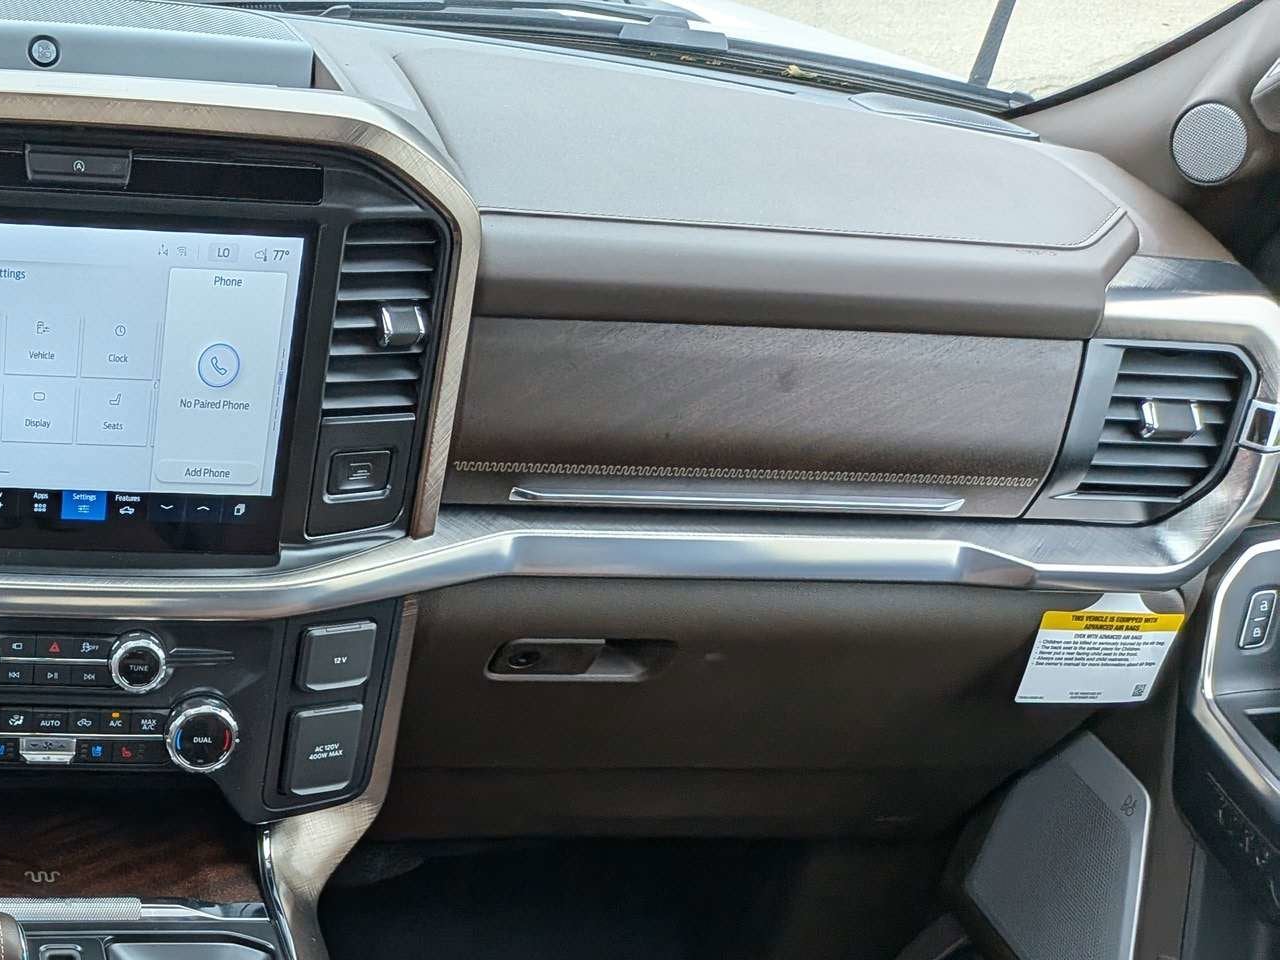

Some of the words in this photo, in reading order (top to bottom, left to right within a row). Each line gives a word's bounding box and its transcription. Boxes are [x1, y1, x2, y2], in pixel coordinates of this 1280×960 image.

[217, 248, 230, 258] LO
[273, 250, 290, 261] 77°
[213, 276, 243, 287] Phone
[29, 350, 55, 360] Vehicle
[108, 354, 128, 364] Clock
[180, 399, 192, 409] No
[193, 399, 221, 410] Paired
[222, 400, 250, 411] Phone
[24, 418, 51, 429] Display
[103, 421, 123, 431] Seats
[184, 467, 202, 478] Add
[203, 467, 231, 478] Phone
[33, 491, 49, 500] Apps
[72, 493, 97, 502] Settings
[115, 494, 141, 503] Features
[129, 664, 149, 672] TUNE
[193, 736, 212, 744] DUAL
[324, 743, 340, 751] 120V
[309, 752, 328, 760] 400W
